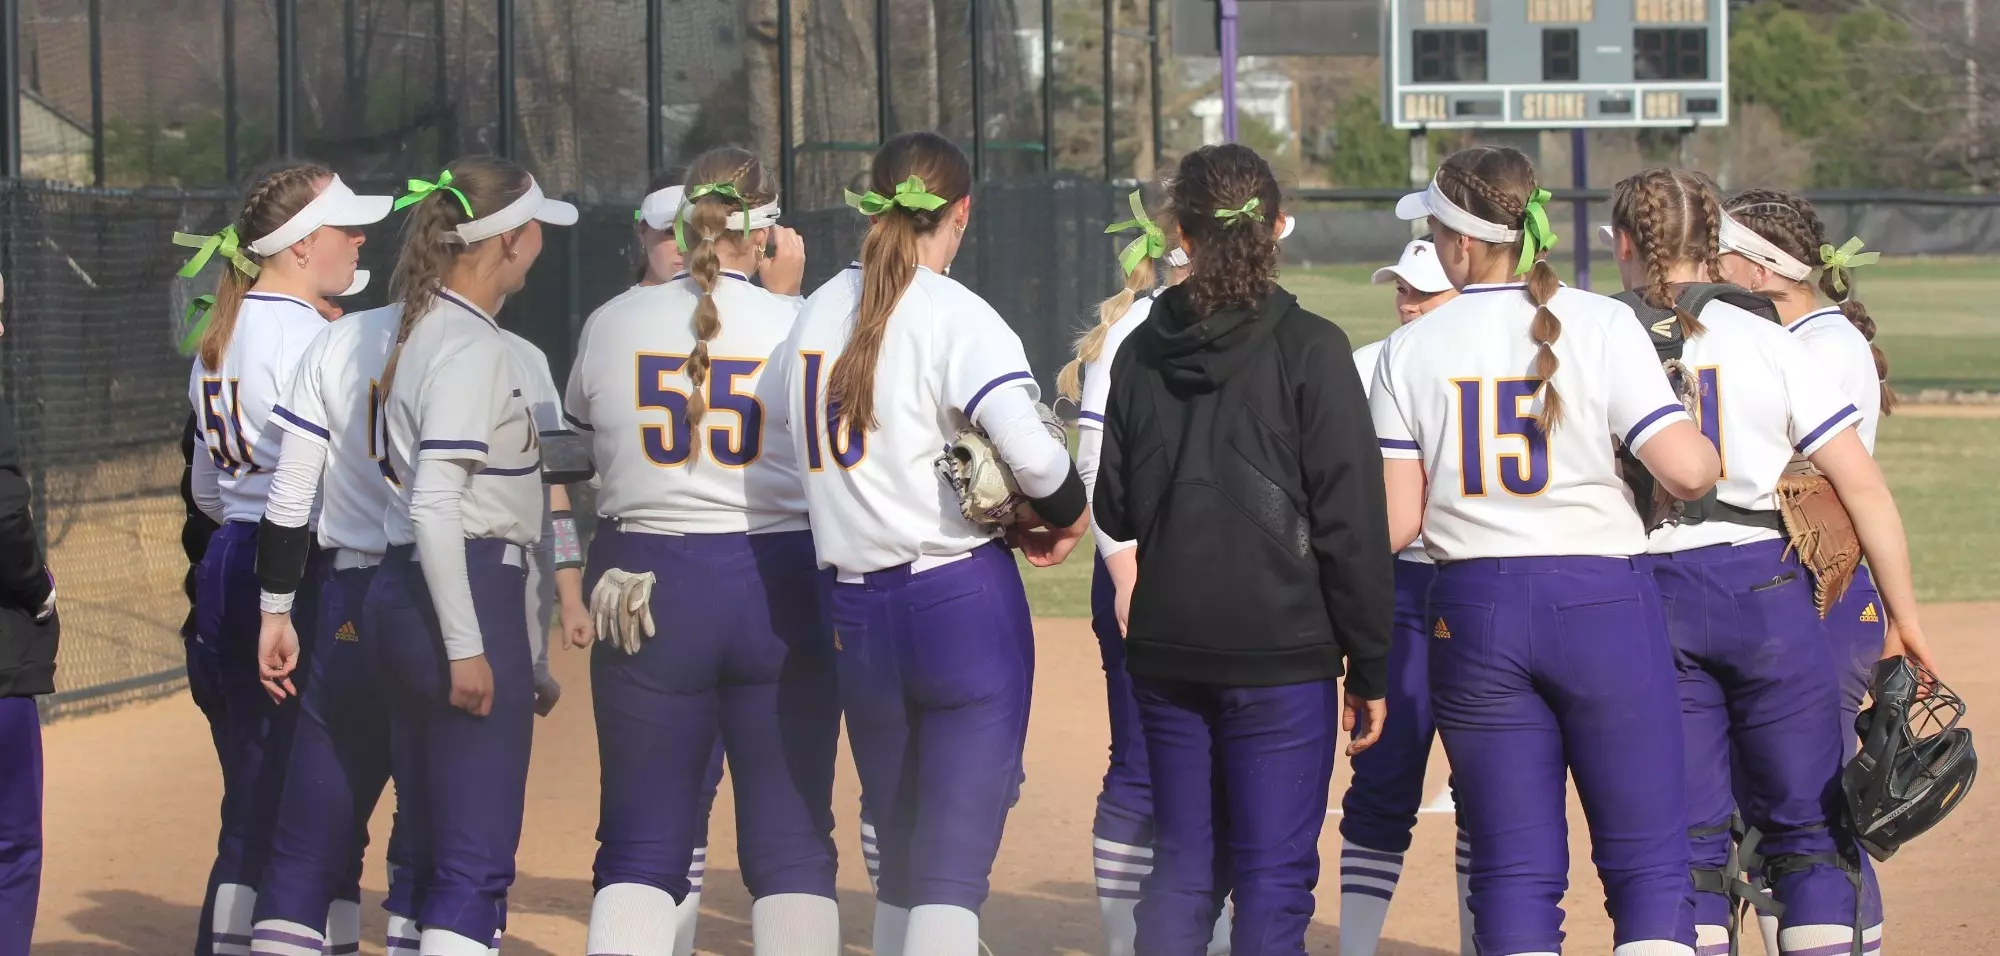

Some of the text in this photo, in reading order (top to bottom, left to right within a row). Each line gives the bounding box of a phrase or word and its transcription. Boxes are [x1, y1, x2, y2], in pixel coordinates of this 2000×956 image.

[1404, 94, 1447, 120] BALL
[1522, 93, 1585, 120] STRIKE
[201, 377, 263, 479] 51
[635, 351, 768, 469] 55
[1448, 376, 1552, 498] 15
